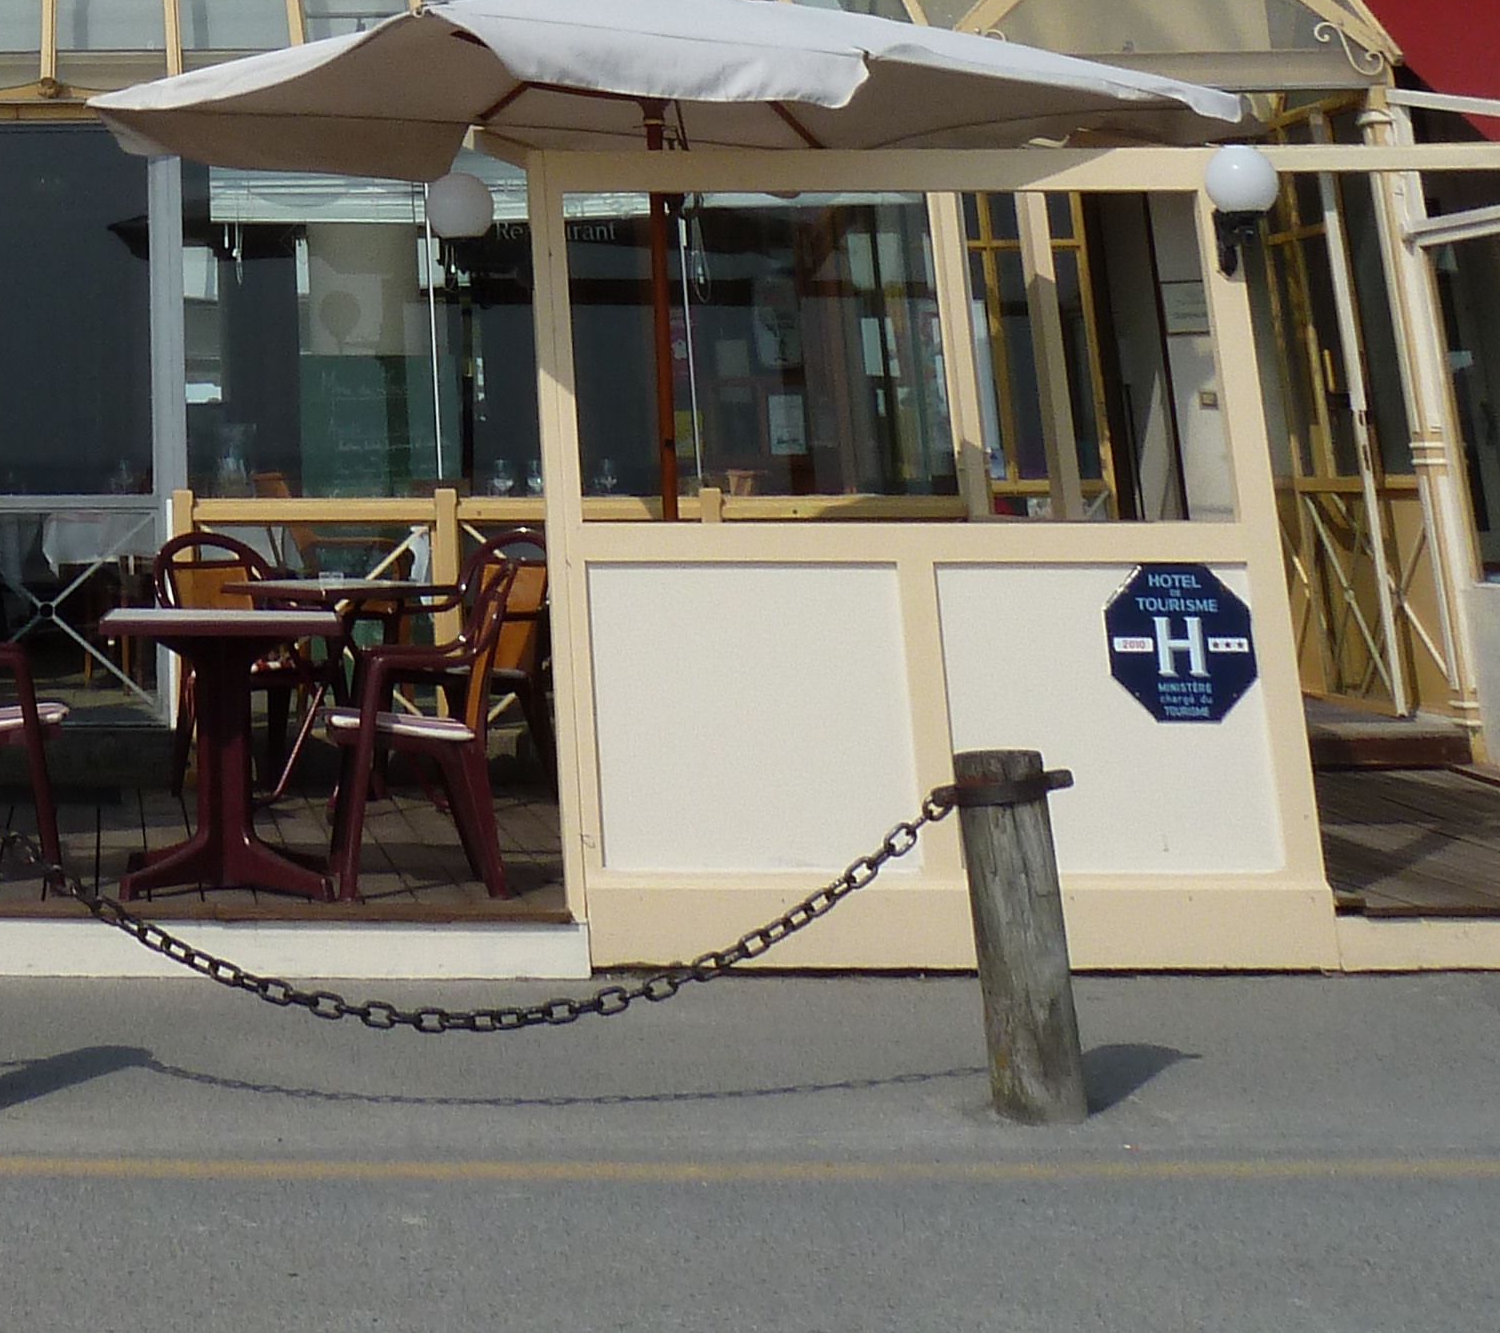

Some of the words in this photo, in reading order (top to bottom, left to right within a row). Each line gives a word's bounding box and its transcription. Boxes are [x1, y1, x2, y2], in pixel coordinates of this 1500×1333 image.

[496, 220, 616, 241] Rerant
[1148, 574, 1201, 588] HOTEL
[1135, 597, 1218, 612] TOURISME
[1122, 639, 1146, 649] 2010
[1153, 617, 1210, 678] H
